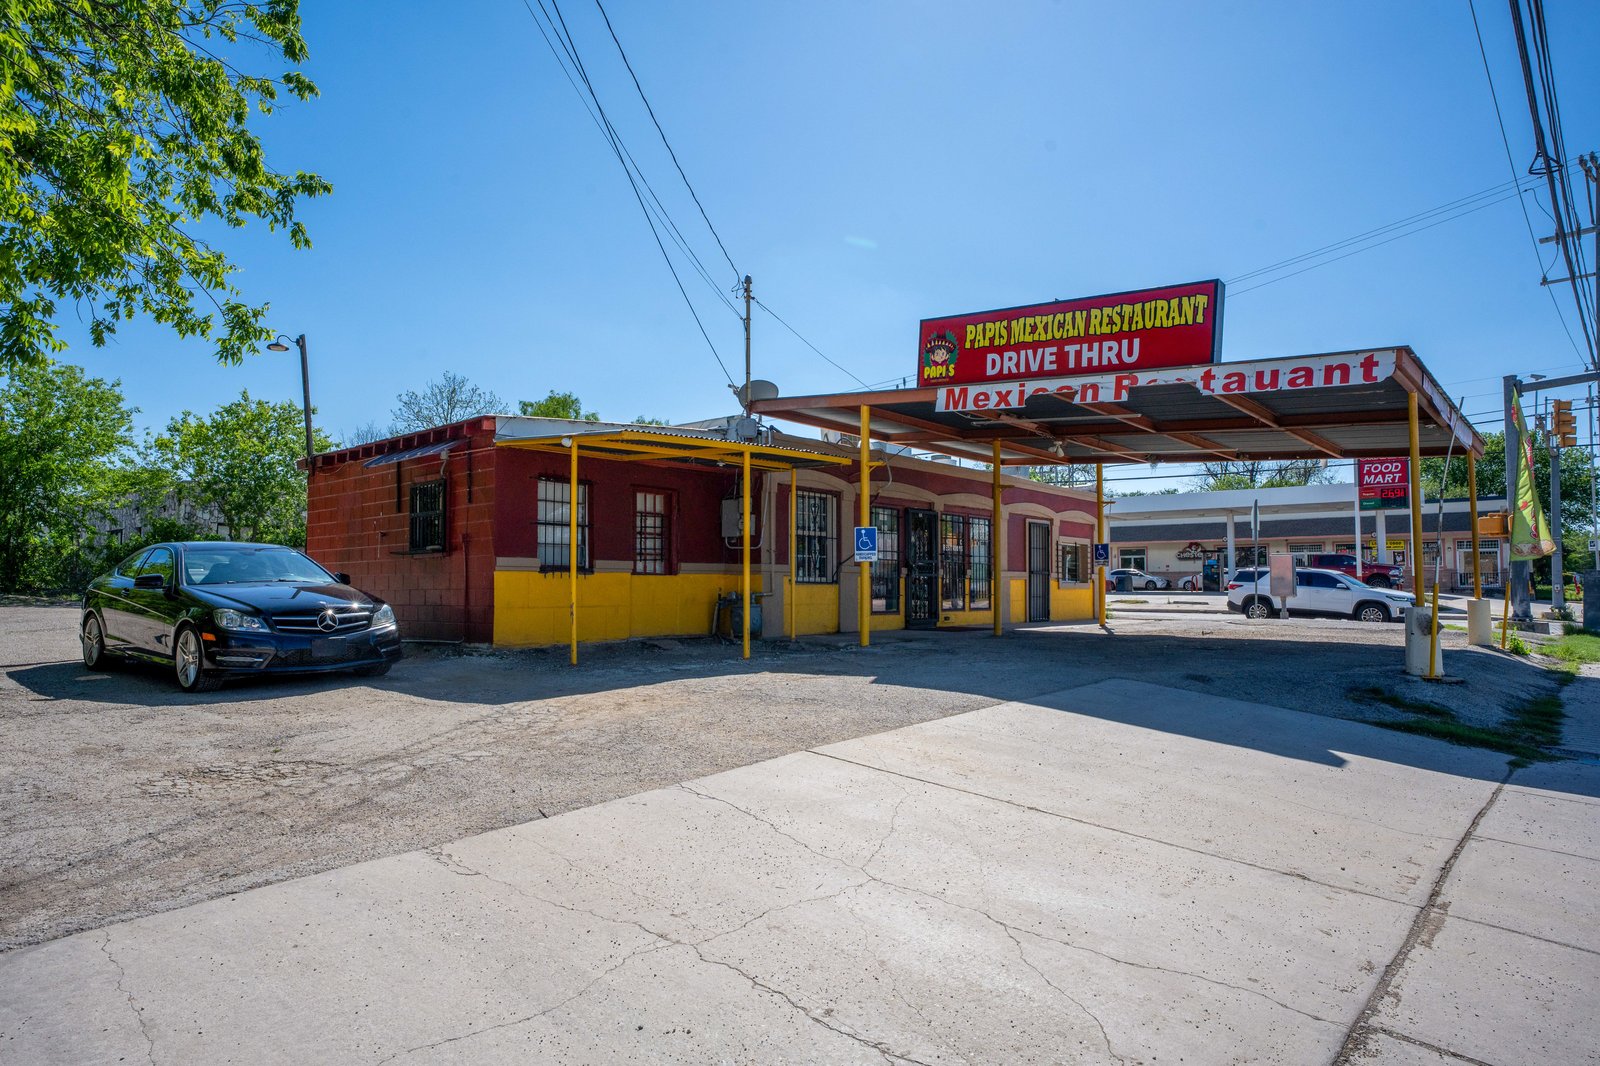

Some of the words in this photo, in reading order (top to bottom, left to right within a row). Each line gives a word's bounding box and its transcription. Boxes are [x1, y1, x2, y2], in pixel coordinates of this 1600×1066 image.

[965, 320, 1008, 349] PAPIS
[1010, 309, 1088, 345] MEXICAN
[1089, 294, 1208, 335] RESTAURANT
[986, 350, 1057, 376] DRIVE
[1064, 338, 1140, 368] THRU
[944, 383, 1099, 411] Mexin
[1363, 462, 1402, 474] FOOD
[1363, 473, 1402, 485] MART
